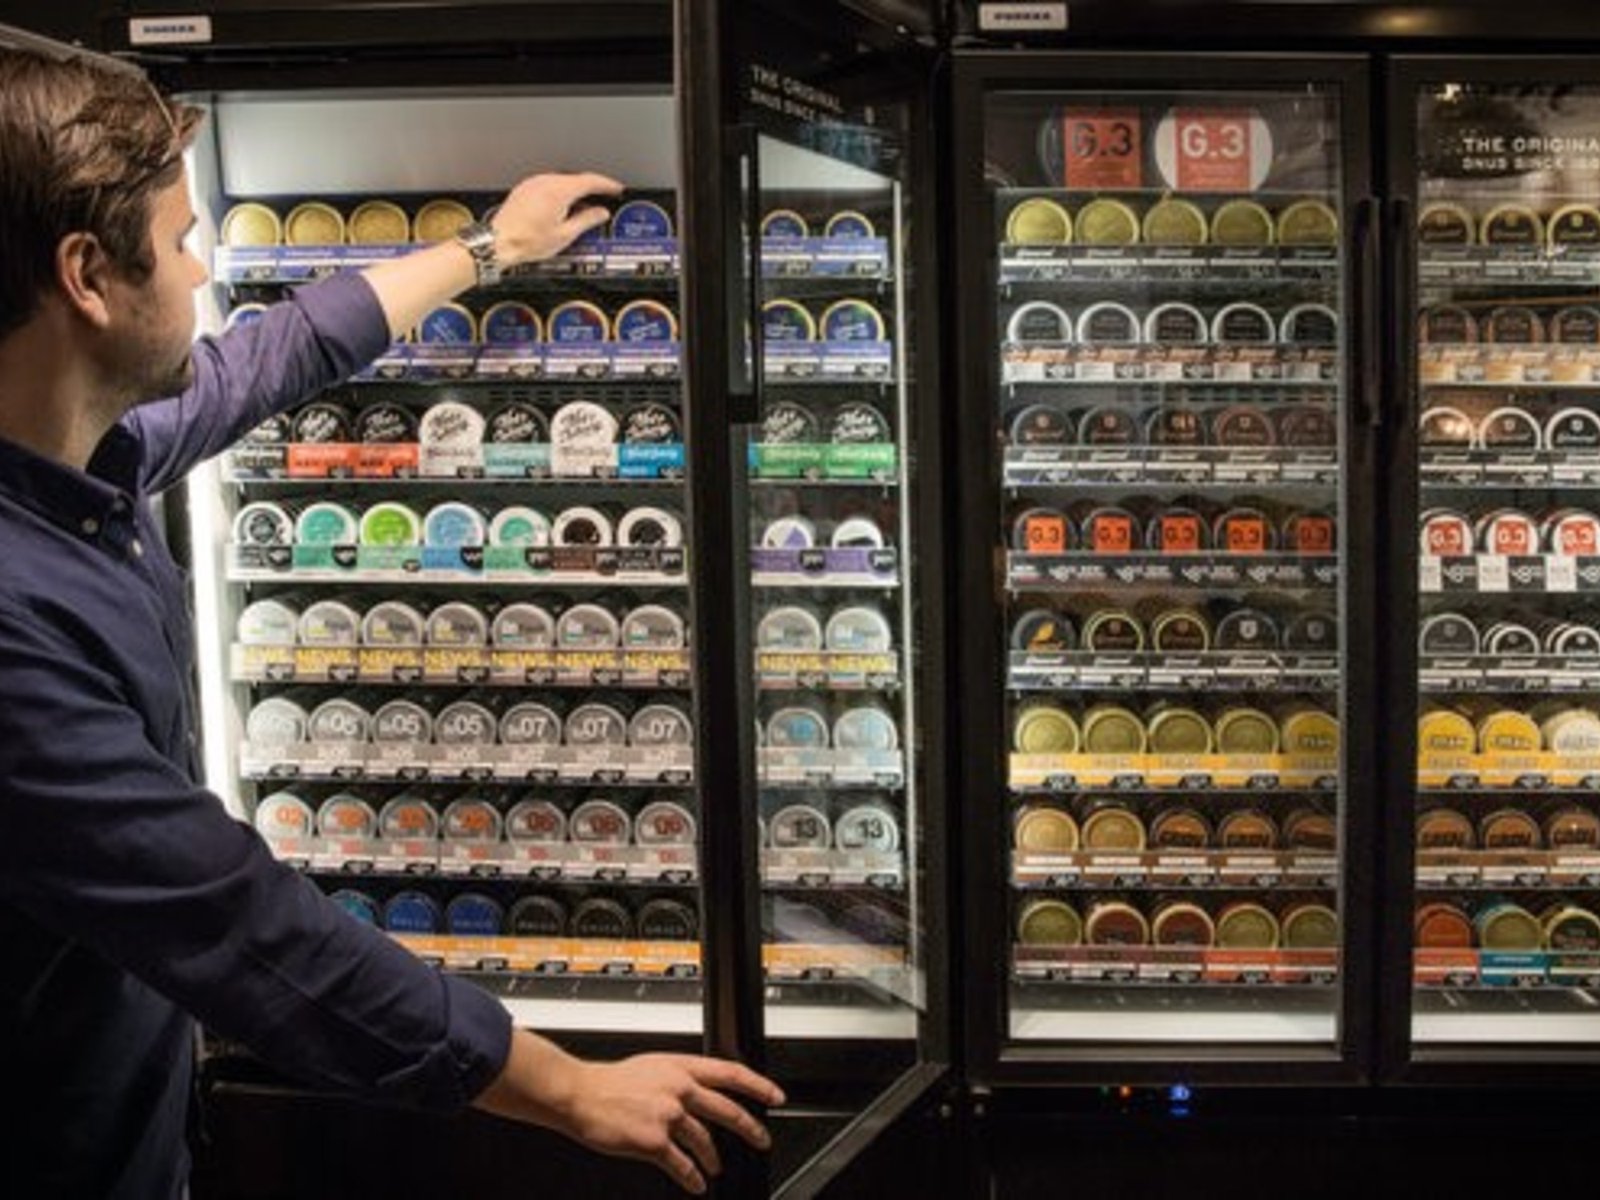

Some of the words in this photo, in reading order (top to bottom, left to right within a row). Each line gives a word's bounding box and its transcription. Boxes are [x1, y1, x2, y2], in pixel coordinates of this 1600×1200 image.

[1072, 121, 1132, 157] G.3
[1181, 122, 1245, 159] G.3
[1462, 137, 1505, 151] THE
[1462, 157, 1508, 170] SNUS
